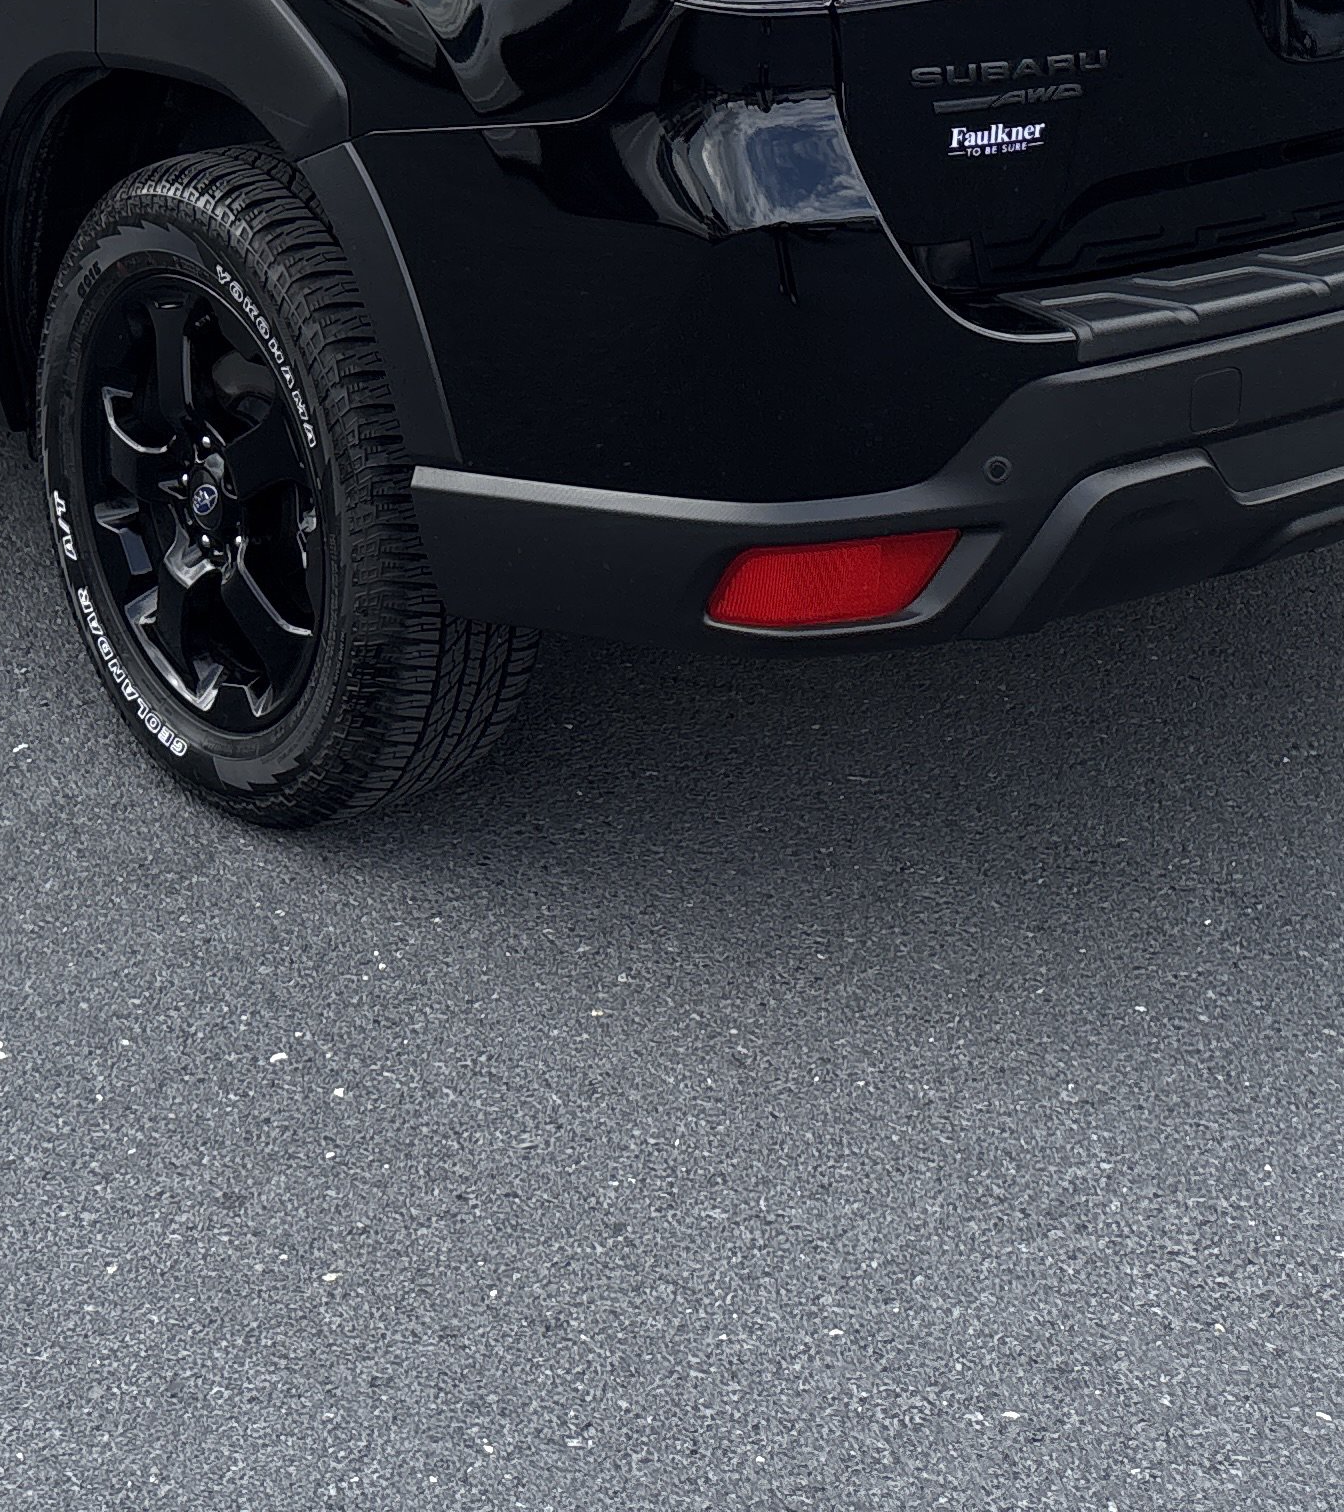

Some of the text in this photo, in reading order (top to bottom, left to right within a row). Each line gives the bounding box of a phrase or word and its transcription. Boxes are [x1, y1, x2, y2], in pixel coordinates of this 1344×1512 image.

[910, 49, 1107, 88] SUBARU
[991, 83, 1084, 108] AWD
[949, 122, 1046, 149] Faulkner
[966, 142, 1028, 157] TO BE SURE
[216, 264, 316, 448] YOKOHAMA
[77, 586, 188, 757] GEOLANDAR
